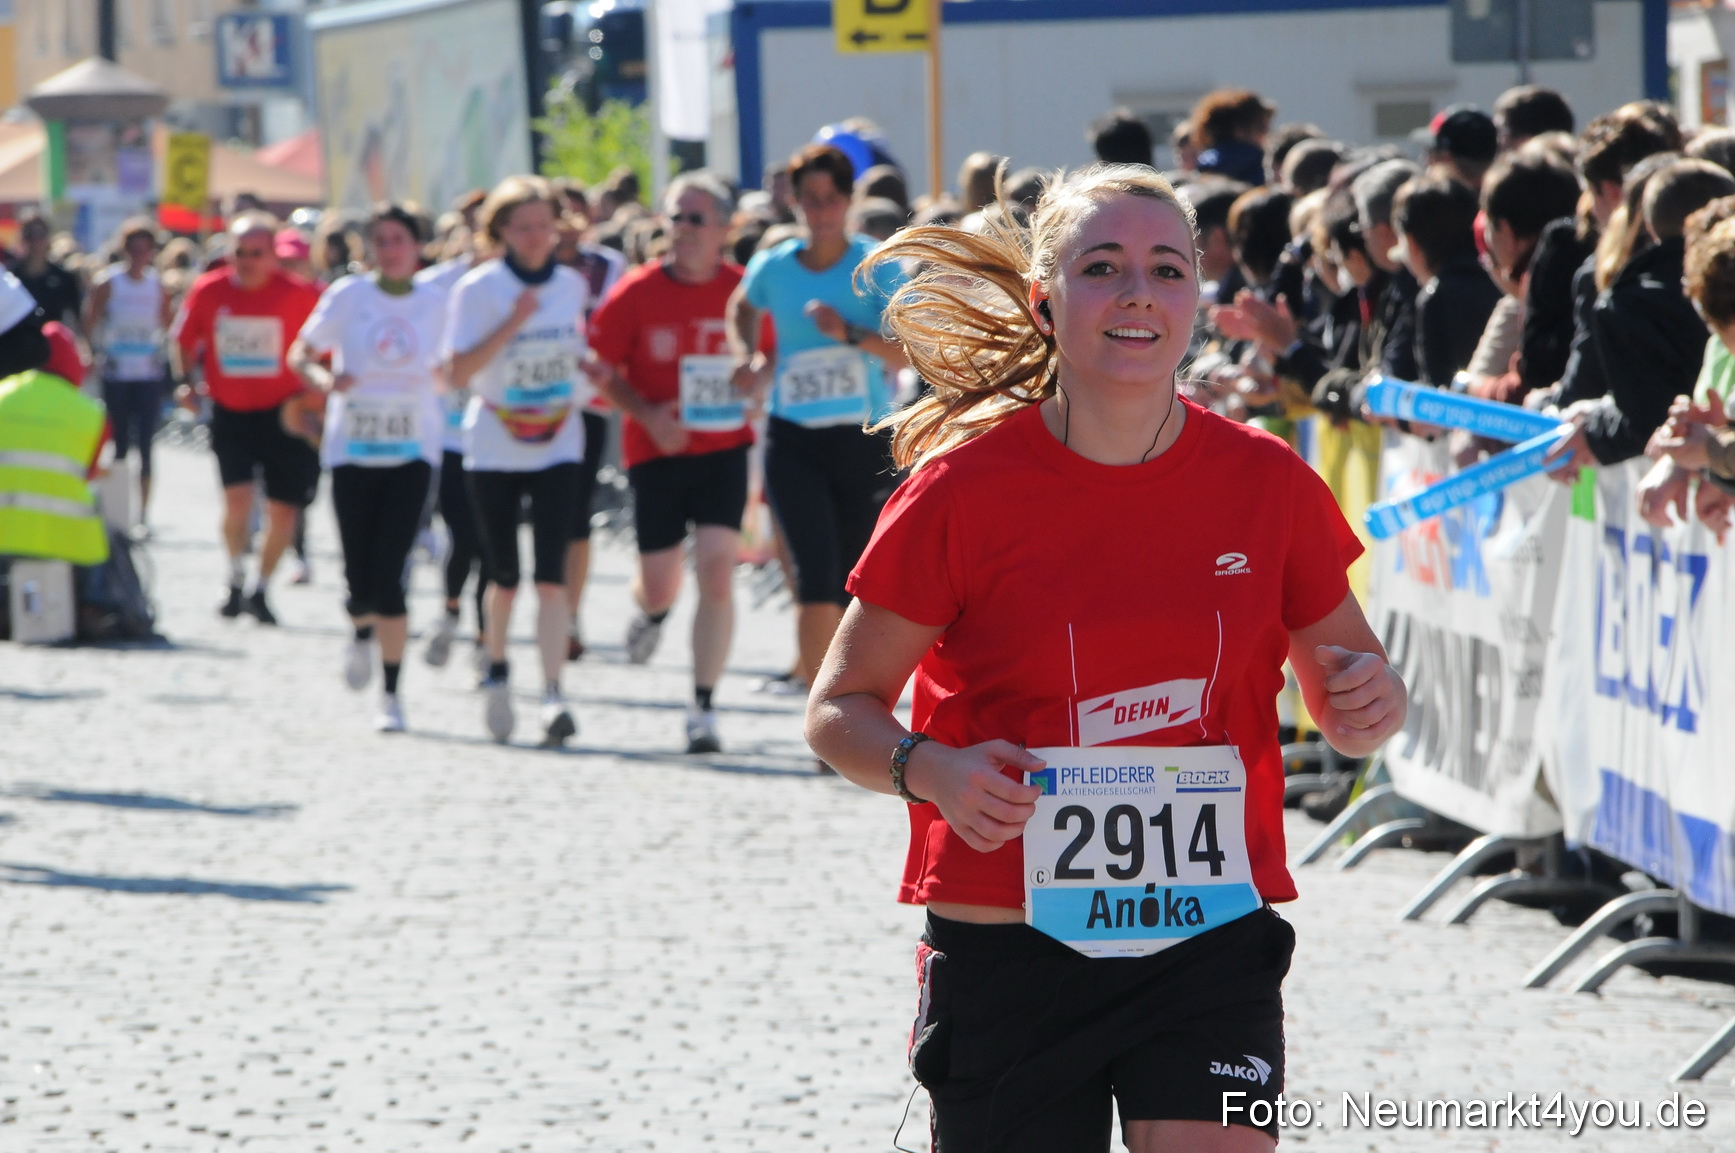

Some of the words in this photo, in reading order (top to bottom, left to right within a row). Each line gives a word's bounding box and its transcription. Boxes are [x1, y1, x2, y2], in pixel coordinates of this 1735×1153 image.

[789, 366, 857, 403] 3575
[1215, 568, 1250, 576] BROOKS
[1113, 696, 1170, 726] DEHN
[1060, 766, 1155, 785] PFLEIDERER
[1175, 770, 1230, 785] BOCK
[1060, 786, 1156, 797] AKTIENGESELLSCHAFT
[1053, 802, 1226, 881] 2914
[1209, 1060, 1259, 1083] JAKO
